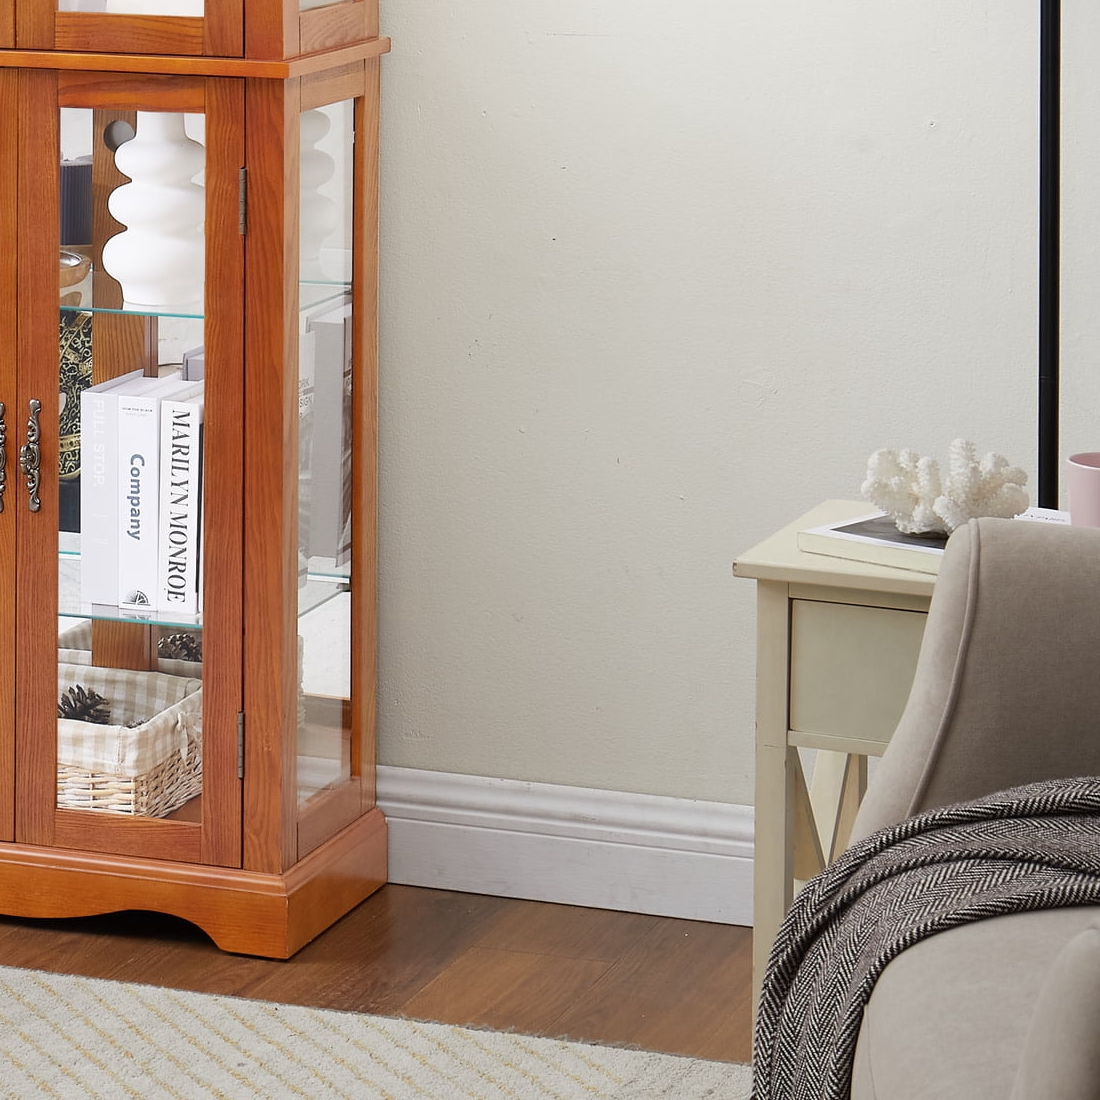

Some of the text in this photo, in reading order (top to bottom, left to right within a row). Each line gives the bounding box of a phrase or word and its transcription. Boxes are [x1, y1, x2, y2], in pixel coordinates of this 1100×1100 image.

[126, 453, 145, 541] Company
[166, 409, 191, 604] MARILYN MONROE
